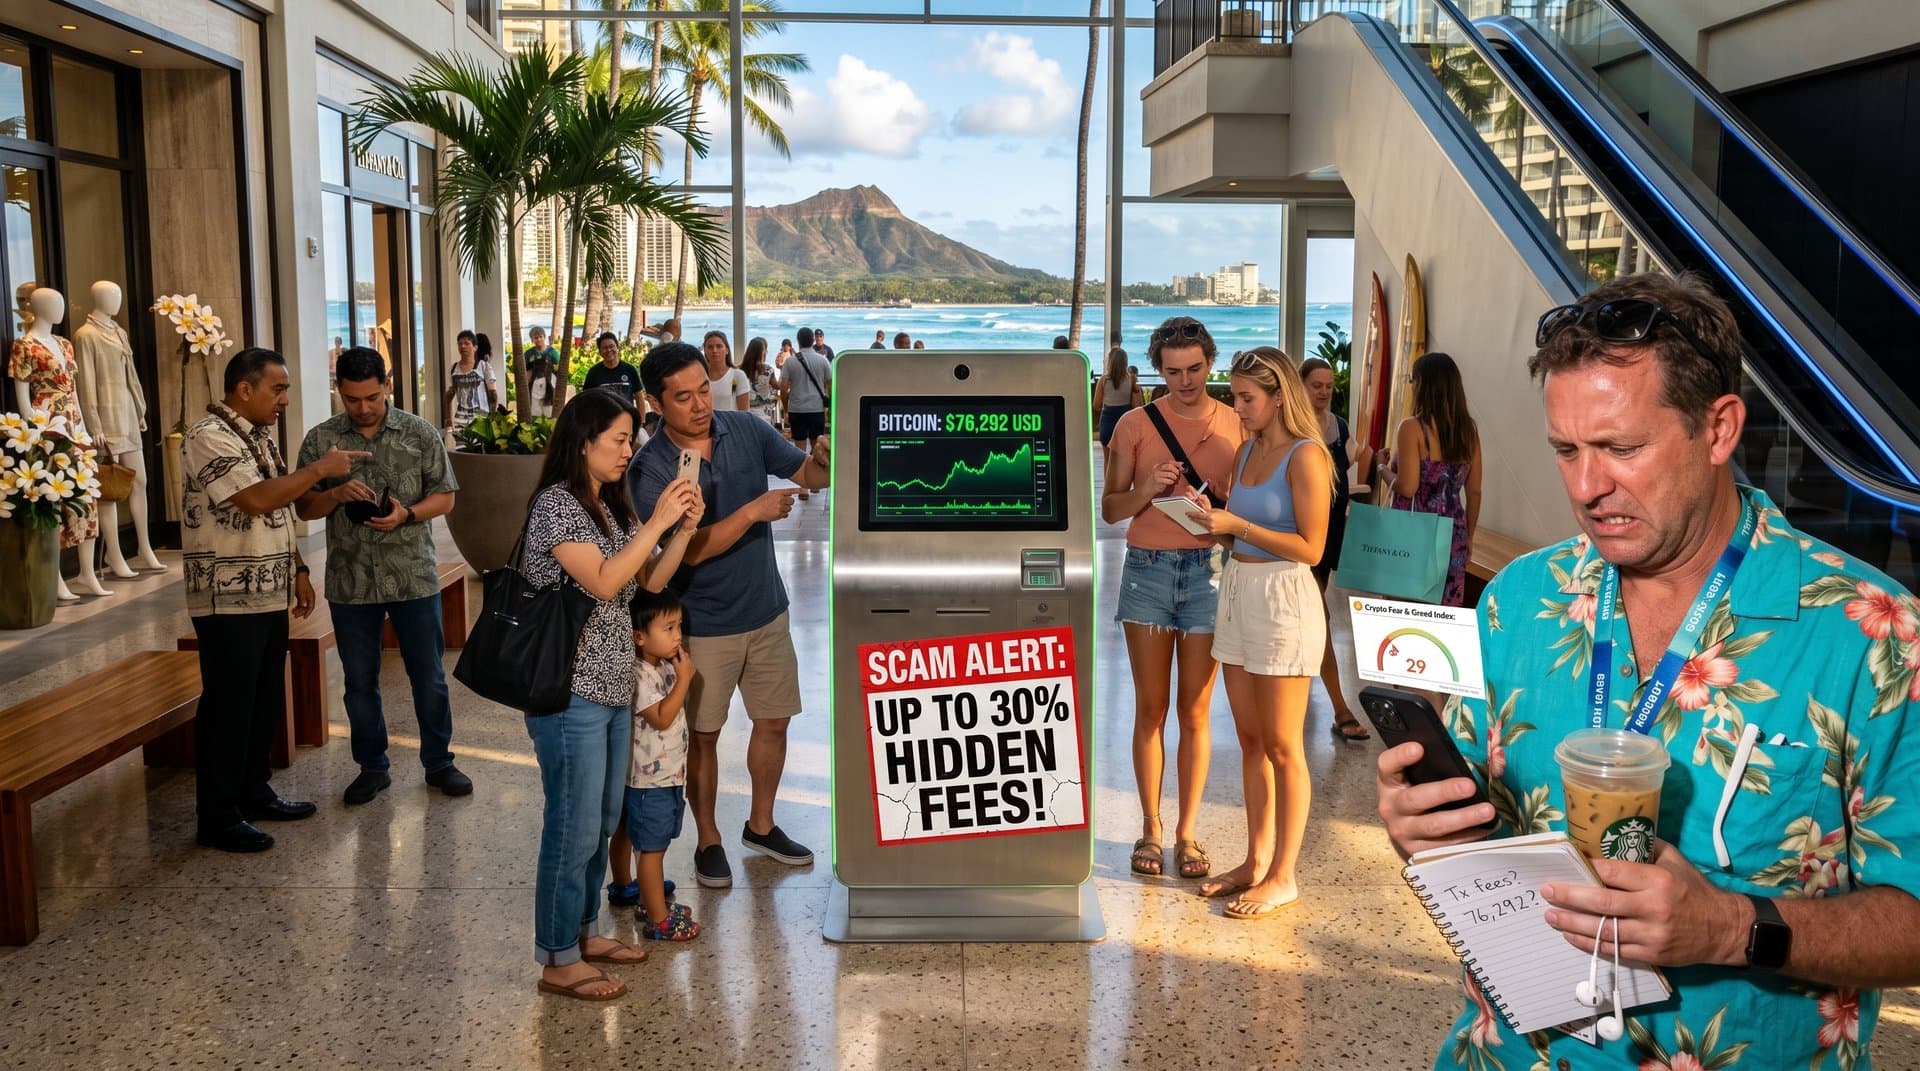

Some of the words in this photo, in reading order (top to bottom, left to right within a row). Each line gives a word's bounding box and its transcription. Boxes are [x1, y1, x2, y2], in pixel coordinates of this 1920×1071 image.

[879, 414, 942, 431] BITCOIN:
[945, 413, 1008, 434] $76,292
[1012, 414, 1042, 431] USD
[1364, 603, 1387, 613] Crypto
[1388, 606, 1403, 615] Fear
[1404, 607, 1410, 615] &
[1411, 609, 1433, 618] Greed
[1433, 611, 1456, 620] Index:
[868, 645, 956, 686] SCAM
[964, 635, 1066, 677] ALERT:
[1406, 658, 1426, 674] 29
[874, 697, 922, 737] UP
[931, 691, 978, 731] TO
[989, 683, 1070, 727] 30%
[885, 727, 1057, 784] HIDDEN
[918, 777, 1046, 831] FEES!
[1443, 885, 1470, 902] Tx
[1473, 870, 1521, 893] fees?
[1463, 889, 1540, 925] 76,292?
